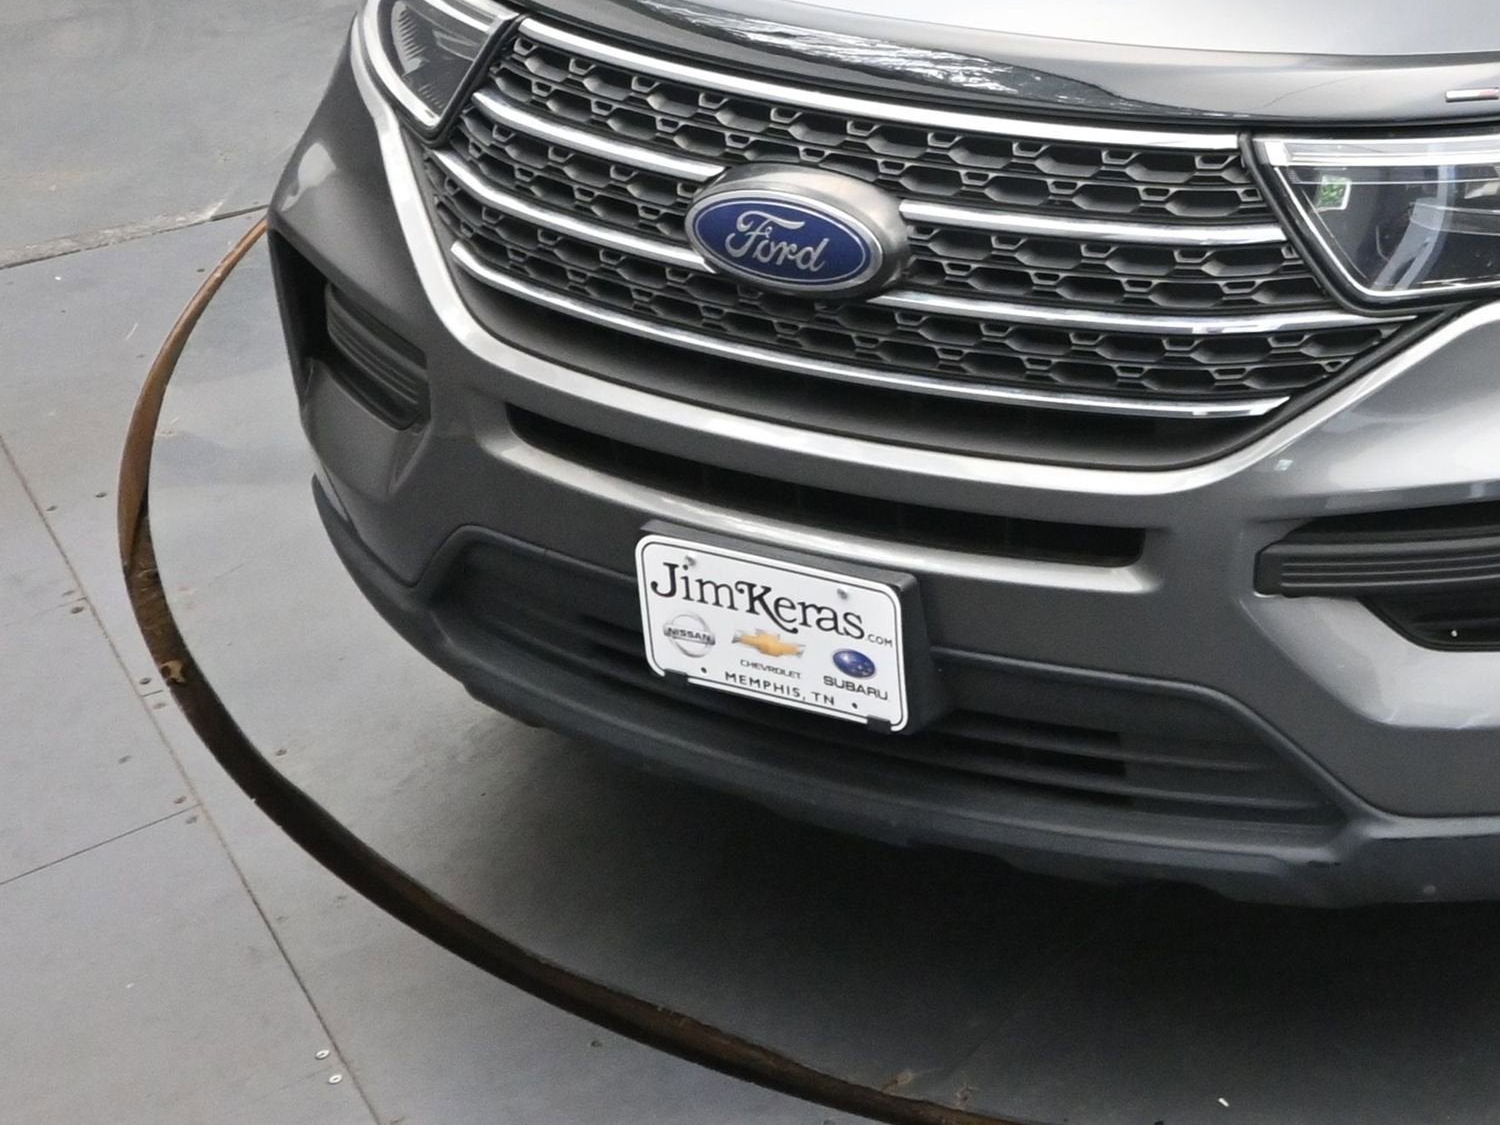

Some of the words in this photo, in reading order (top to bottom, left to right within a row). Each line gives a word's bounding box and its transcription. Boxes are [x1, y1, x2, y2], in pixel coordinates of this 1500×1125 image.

[725, 210, 829, 272] Ford
[666, 627, 711, 643] NISSAN
[739, 658, 801, 679] CHEVROLET
[724, 671, 806, 701] MEMPHIS,
[811, 691, 835, 706] TN
[823, 675, 888, 701] SUBARU
